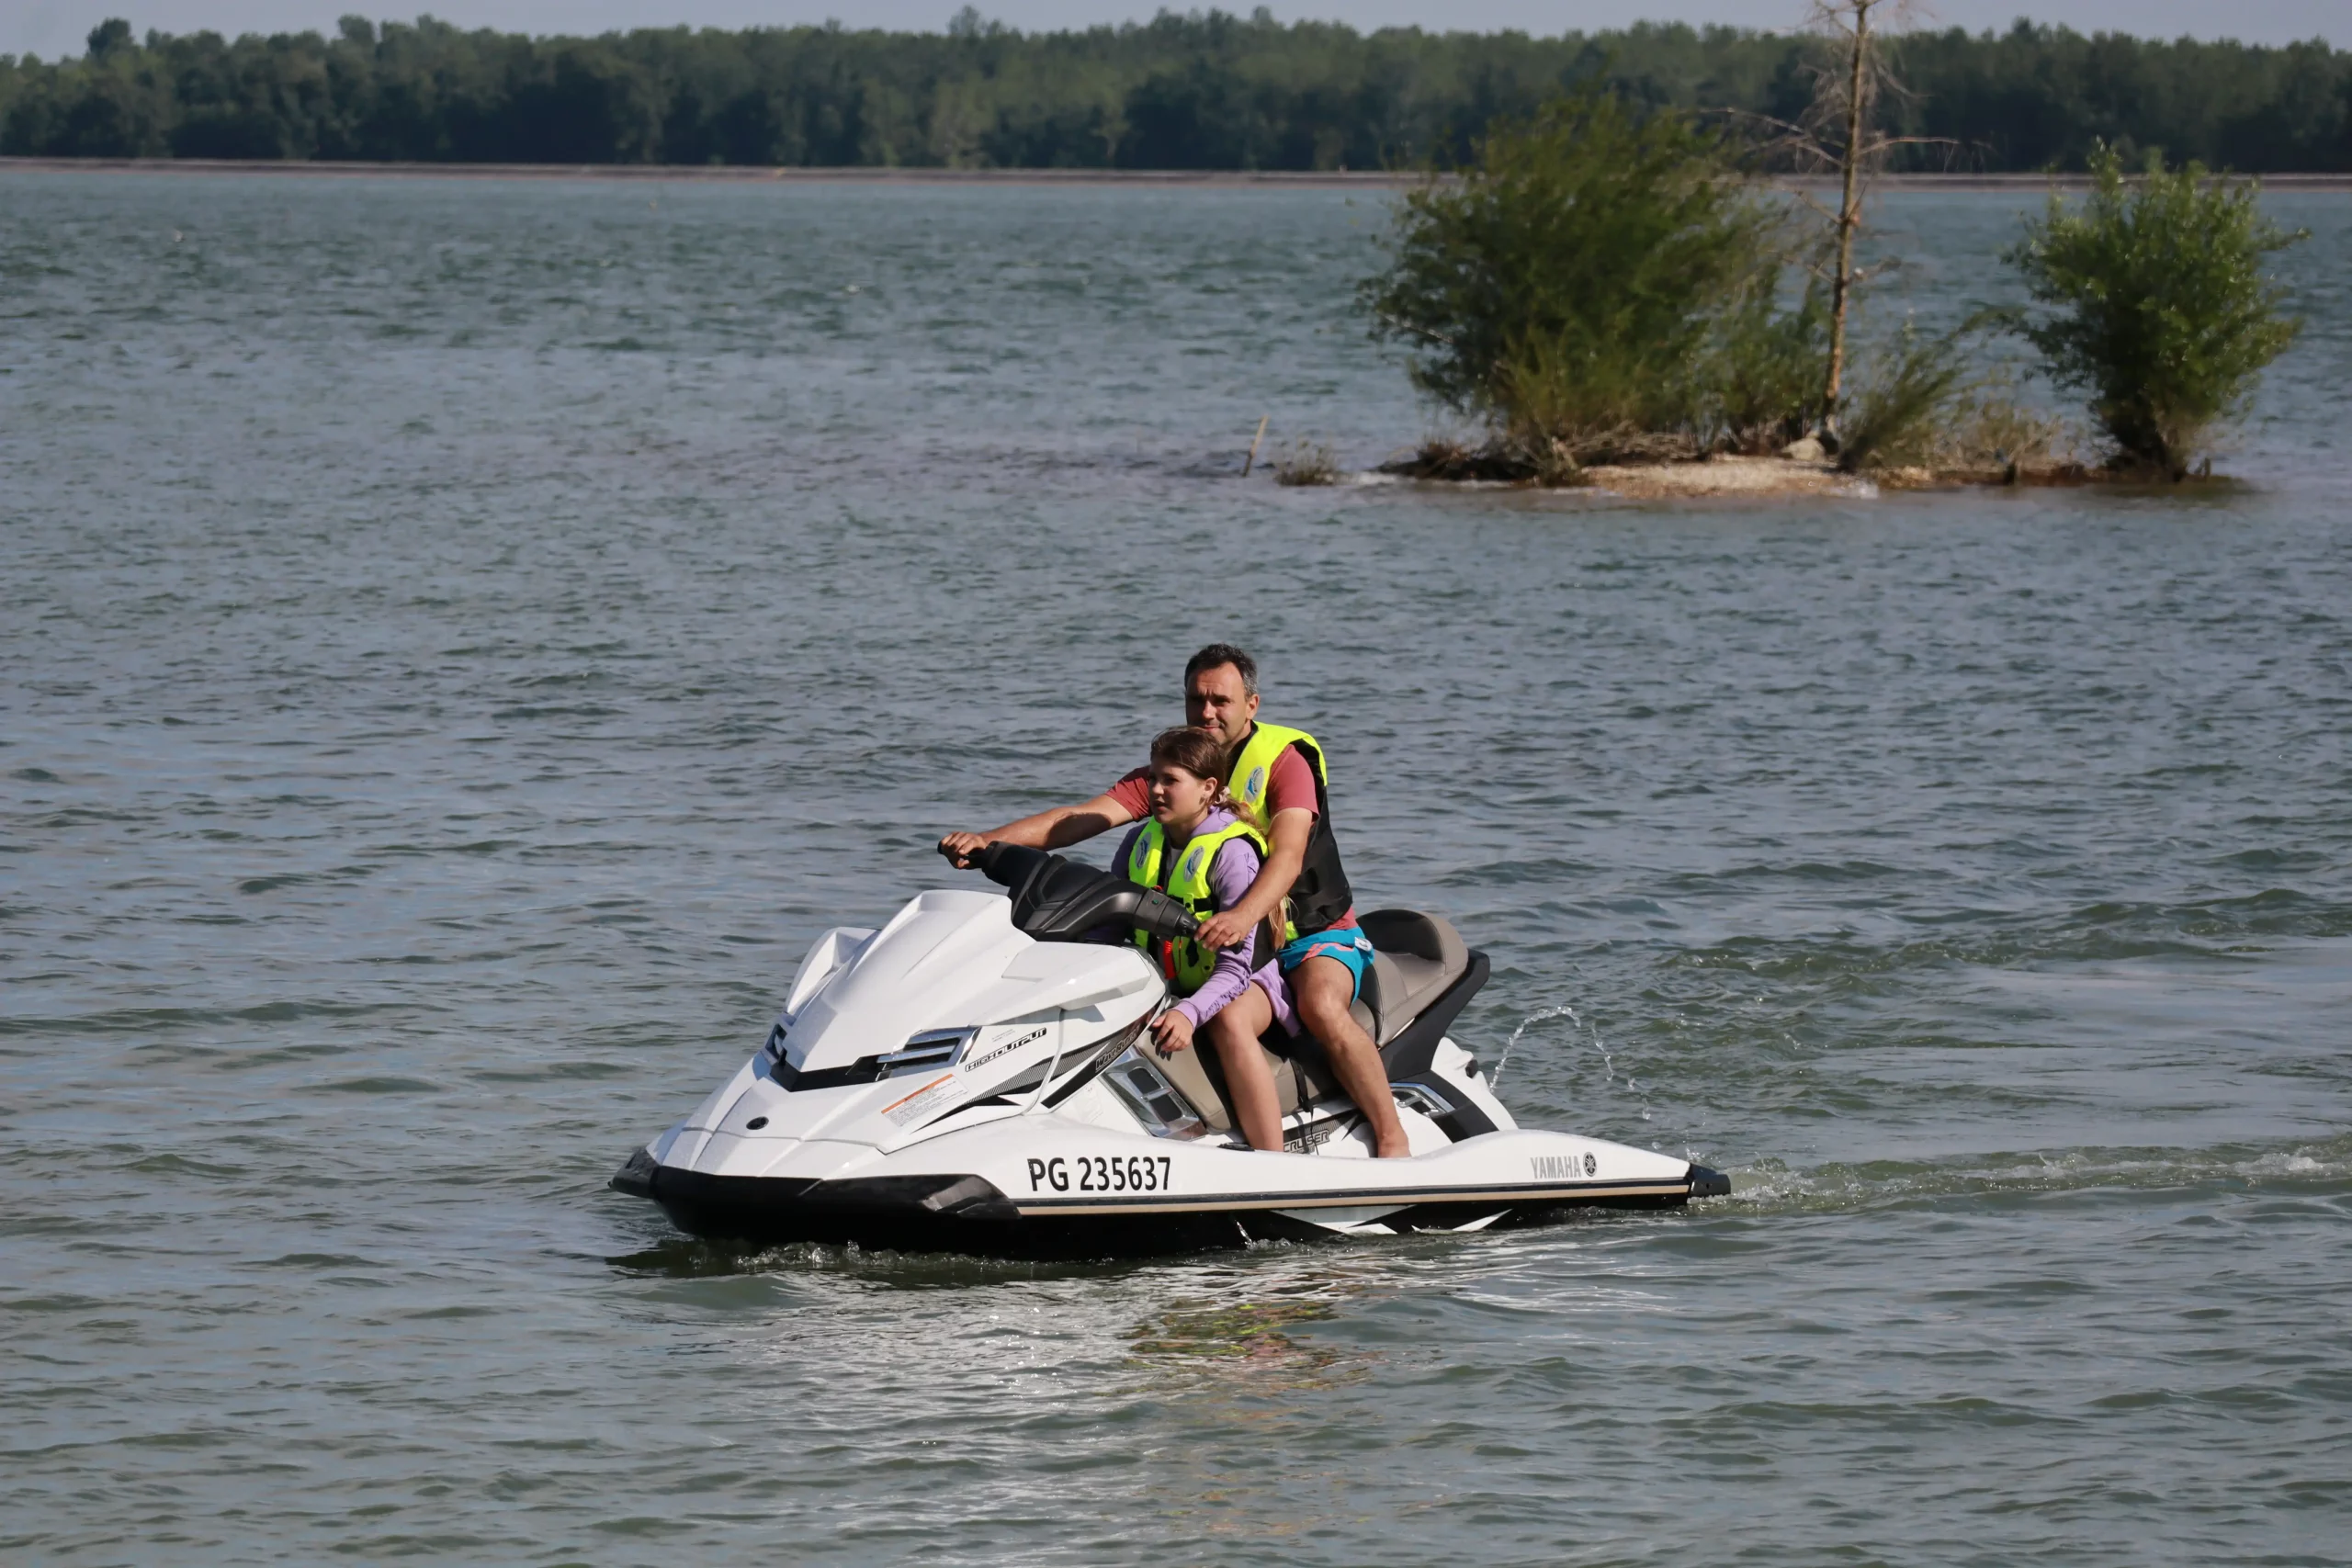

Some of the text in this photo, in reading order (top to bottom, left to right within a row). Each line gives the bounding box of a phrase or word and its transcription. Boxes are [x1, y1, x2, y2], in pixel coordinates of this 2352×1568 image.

[1283, 1130, 1329, 1153] CRUSER
[1027, 1156, 1170, 1192] PG 235637
[1530, 1156, 1582, 1179] YAMAHA
